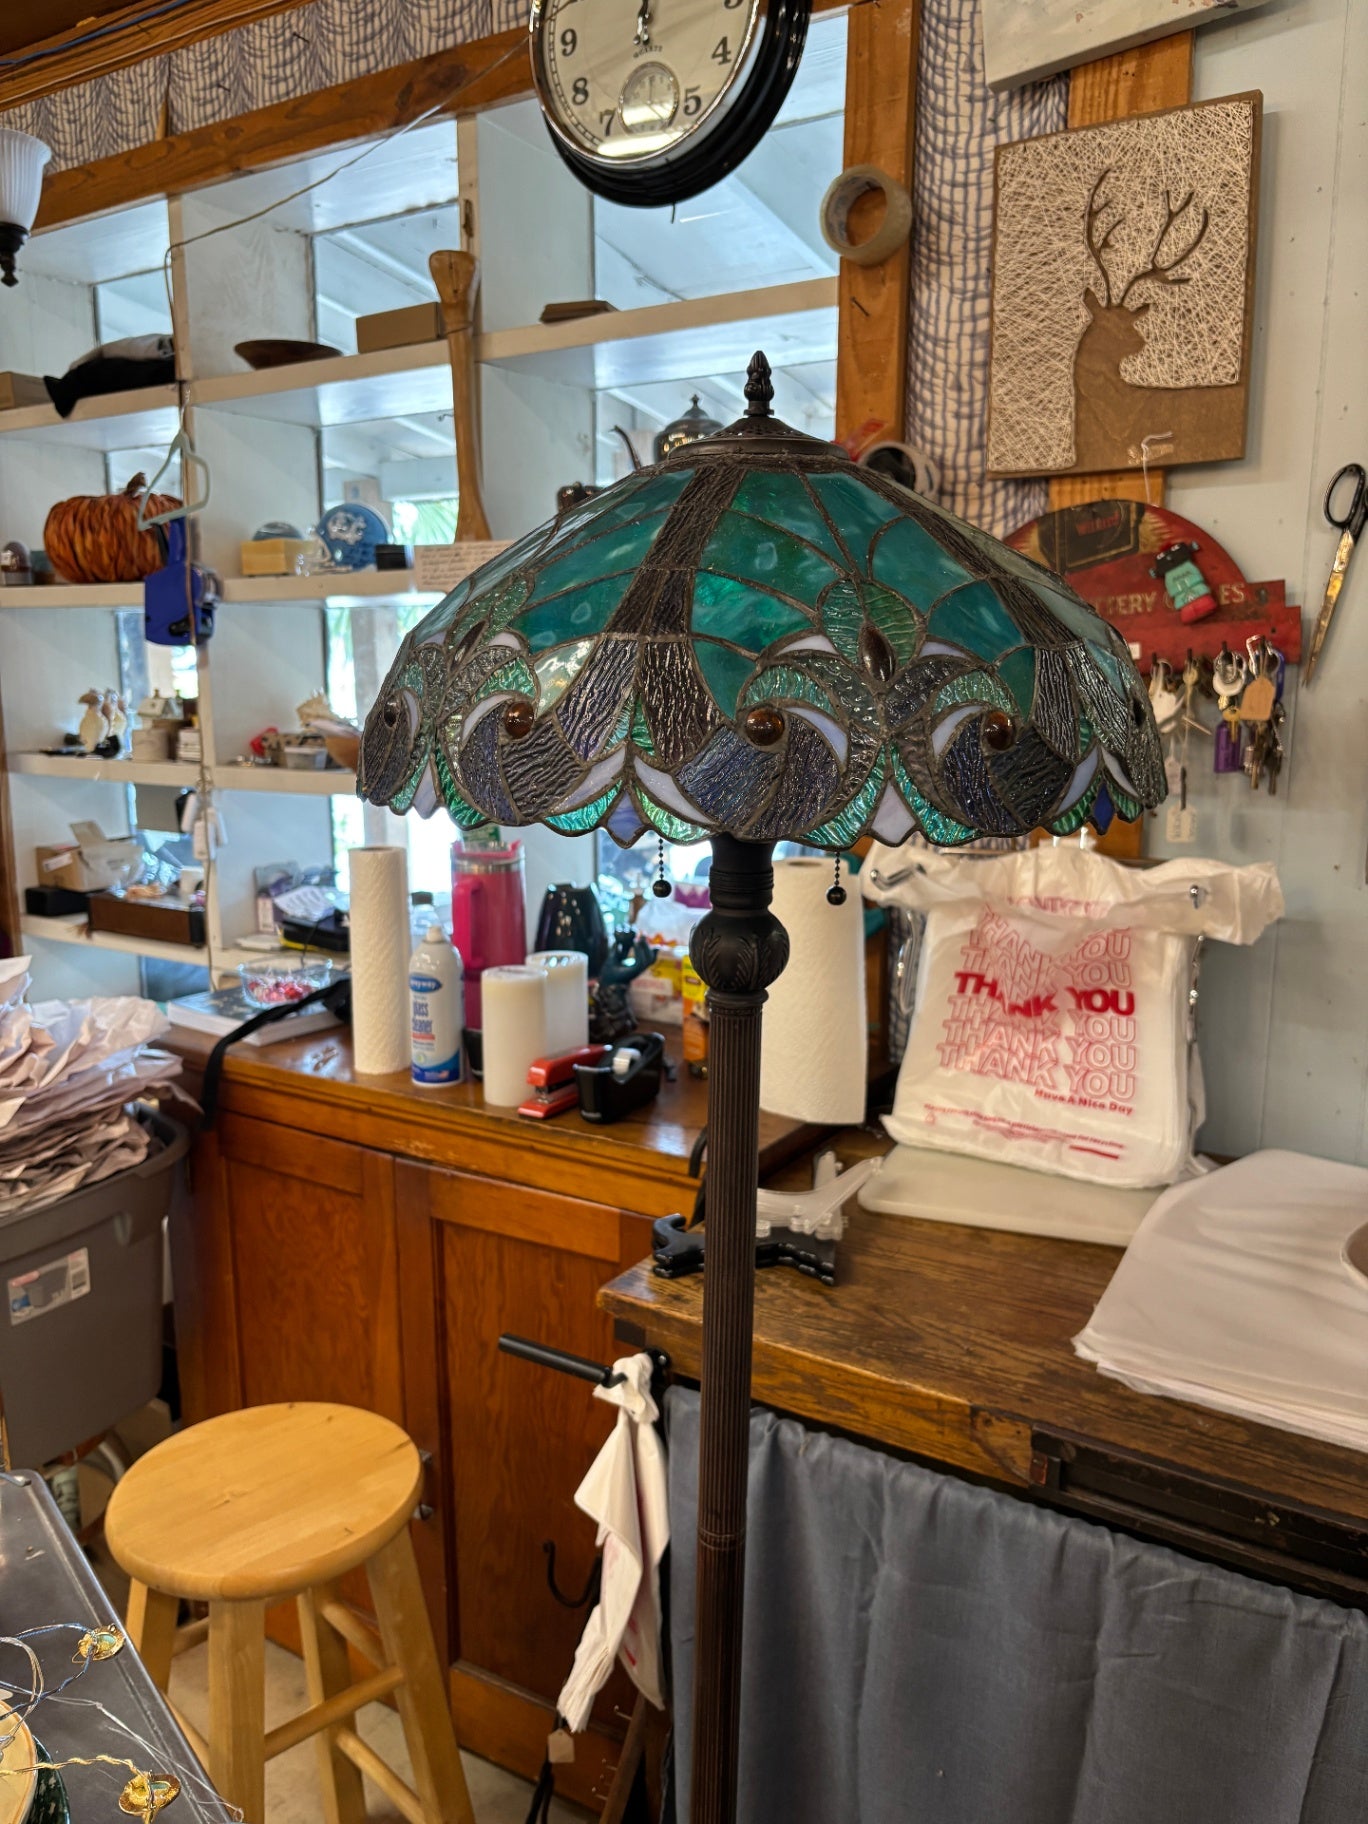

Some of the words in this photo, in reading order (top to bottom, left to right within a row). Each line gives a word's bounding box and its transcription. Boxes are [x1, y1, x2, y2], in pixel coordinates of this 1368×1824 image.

[560, 28, 577, 57] 9
[711, 36, 731, 65] 4
[572, 77, 589, 105] 8
[683, 86, 702, 116] 5
[600, 108, 616, 136] 7
[1062, 960, 1133, 989] YOU
[1065, 986, 1136, 1016] YOU
[1068, 1009, 1137, 1044] YOU
[942, 1019, 1061, 1066] THANK
[1065, 1036, 1137, 1072] YOU
[936, 1043, 1058, 1091] THANK
[1063, 1063, 1136, 1101] YOU
[1034, 1089, 1066, 1104] Have
[1067, 1095, 1077, 1106] A
[1078, 1098, 1106, 1110] Nice
[1109, 1103, 1134, 1116] Day
